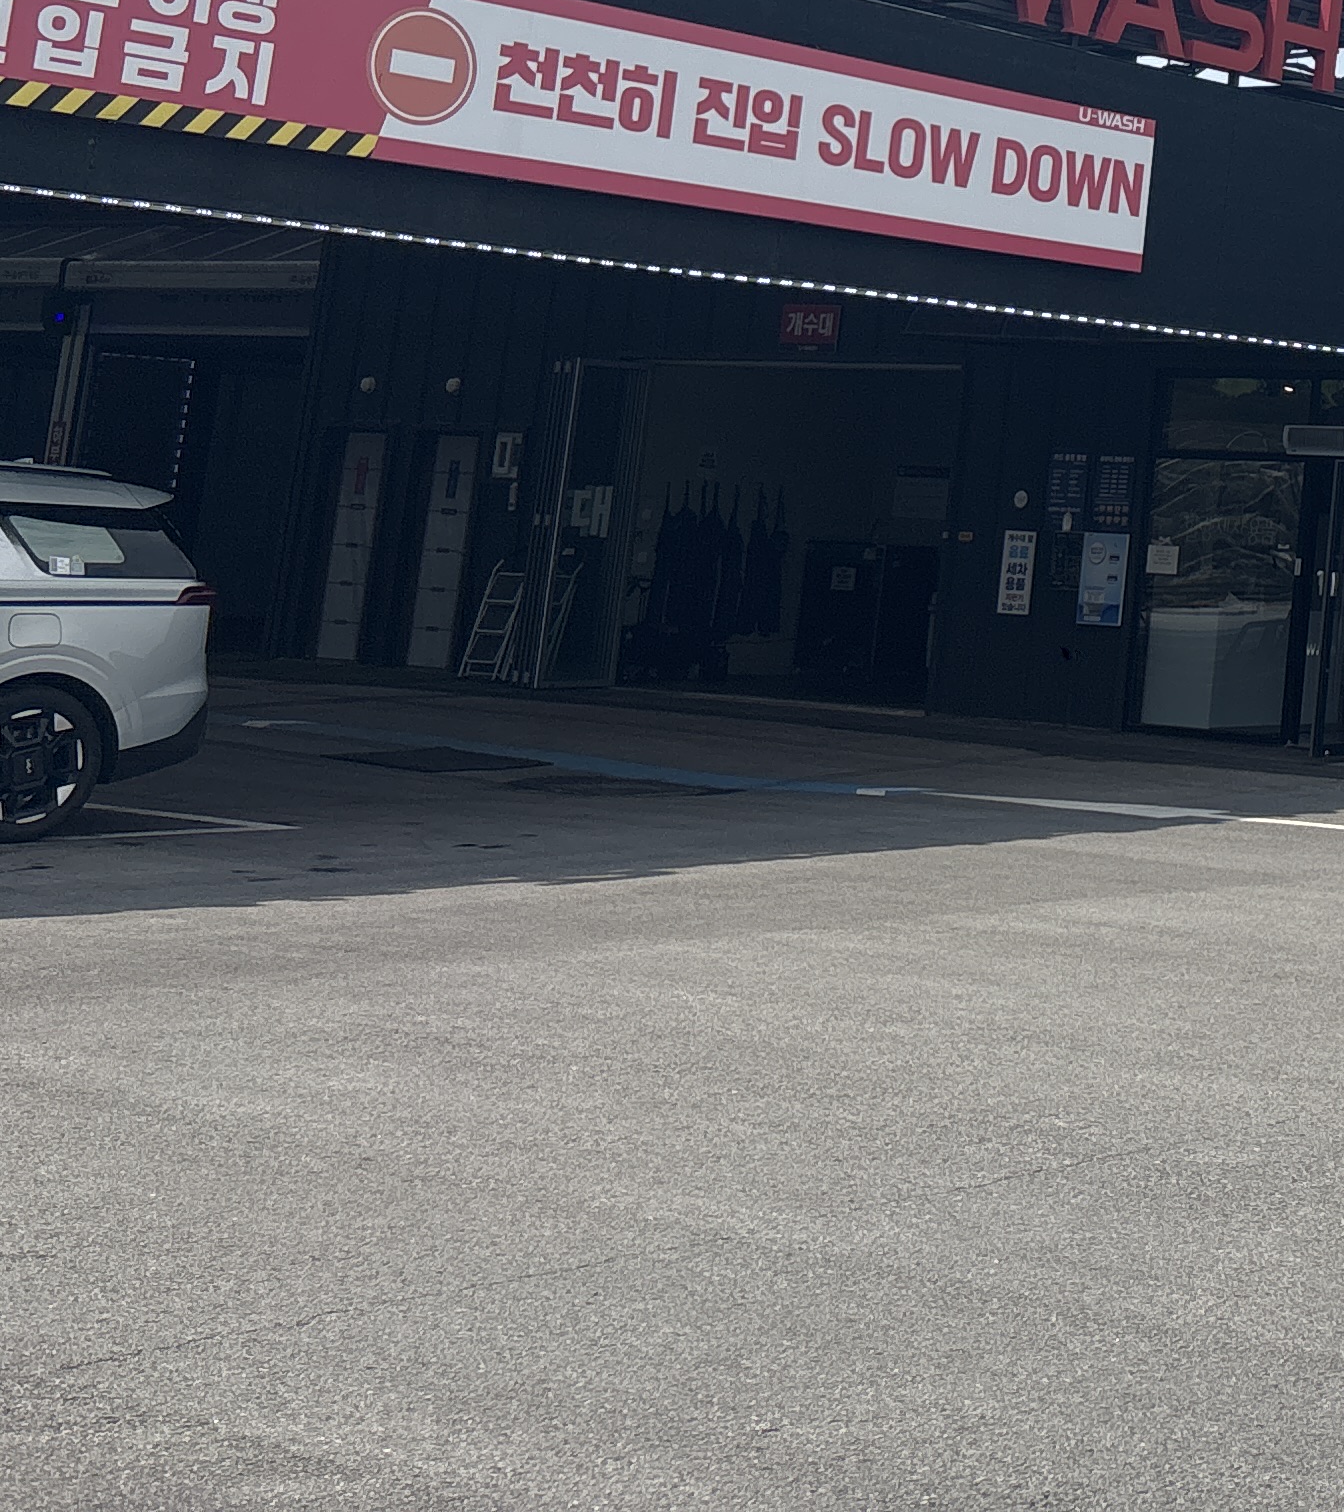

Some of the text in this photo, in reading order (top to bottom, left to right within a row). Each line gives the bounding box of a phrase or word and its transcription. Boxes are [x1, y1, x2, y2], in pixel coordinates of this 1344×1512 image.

[493, 41, 1145, 218] 천천히 진입 SLOW DOWN
[1078, 106, 1146, 133] U-WASH
[786, 312, 835, 336] 개수대
[1006, 562, 1028, 576] 세차
[1005, 576, 1026, 591] 용품
